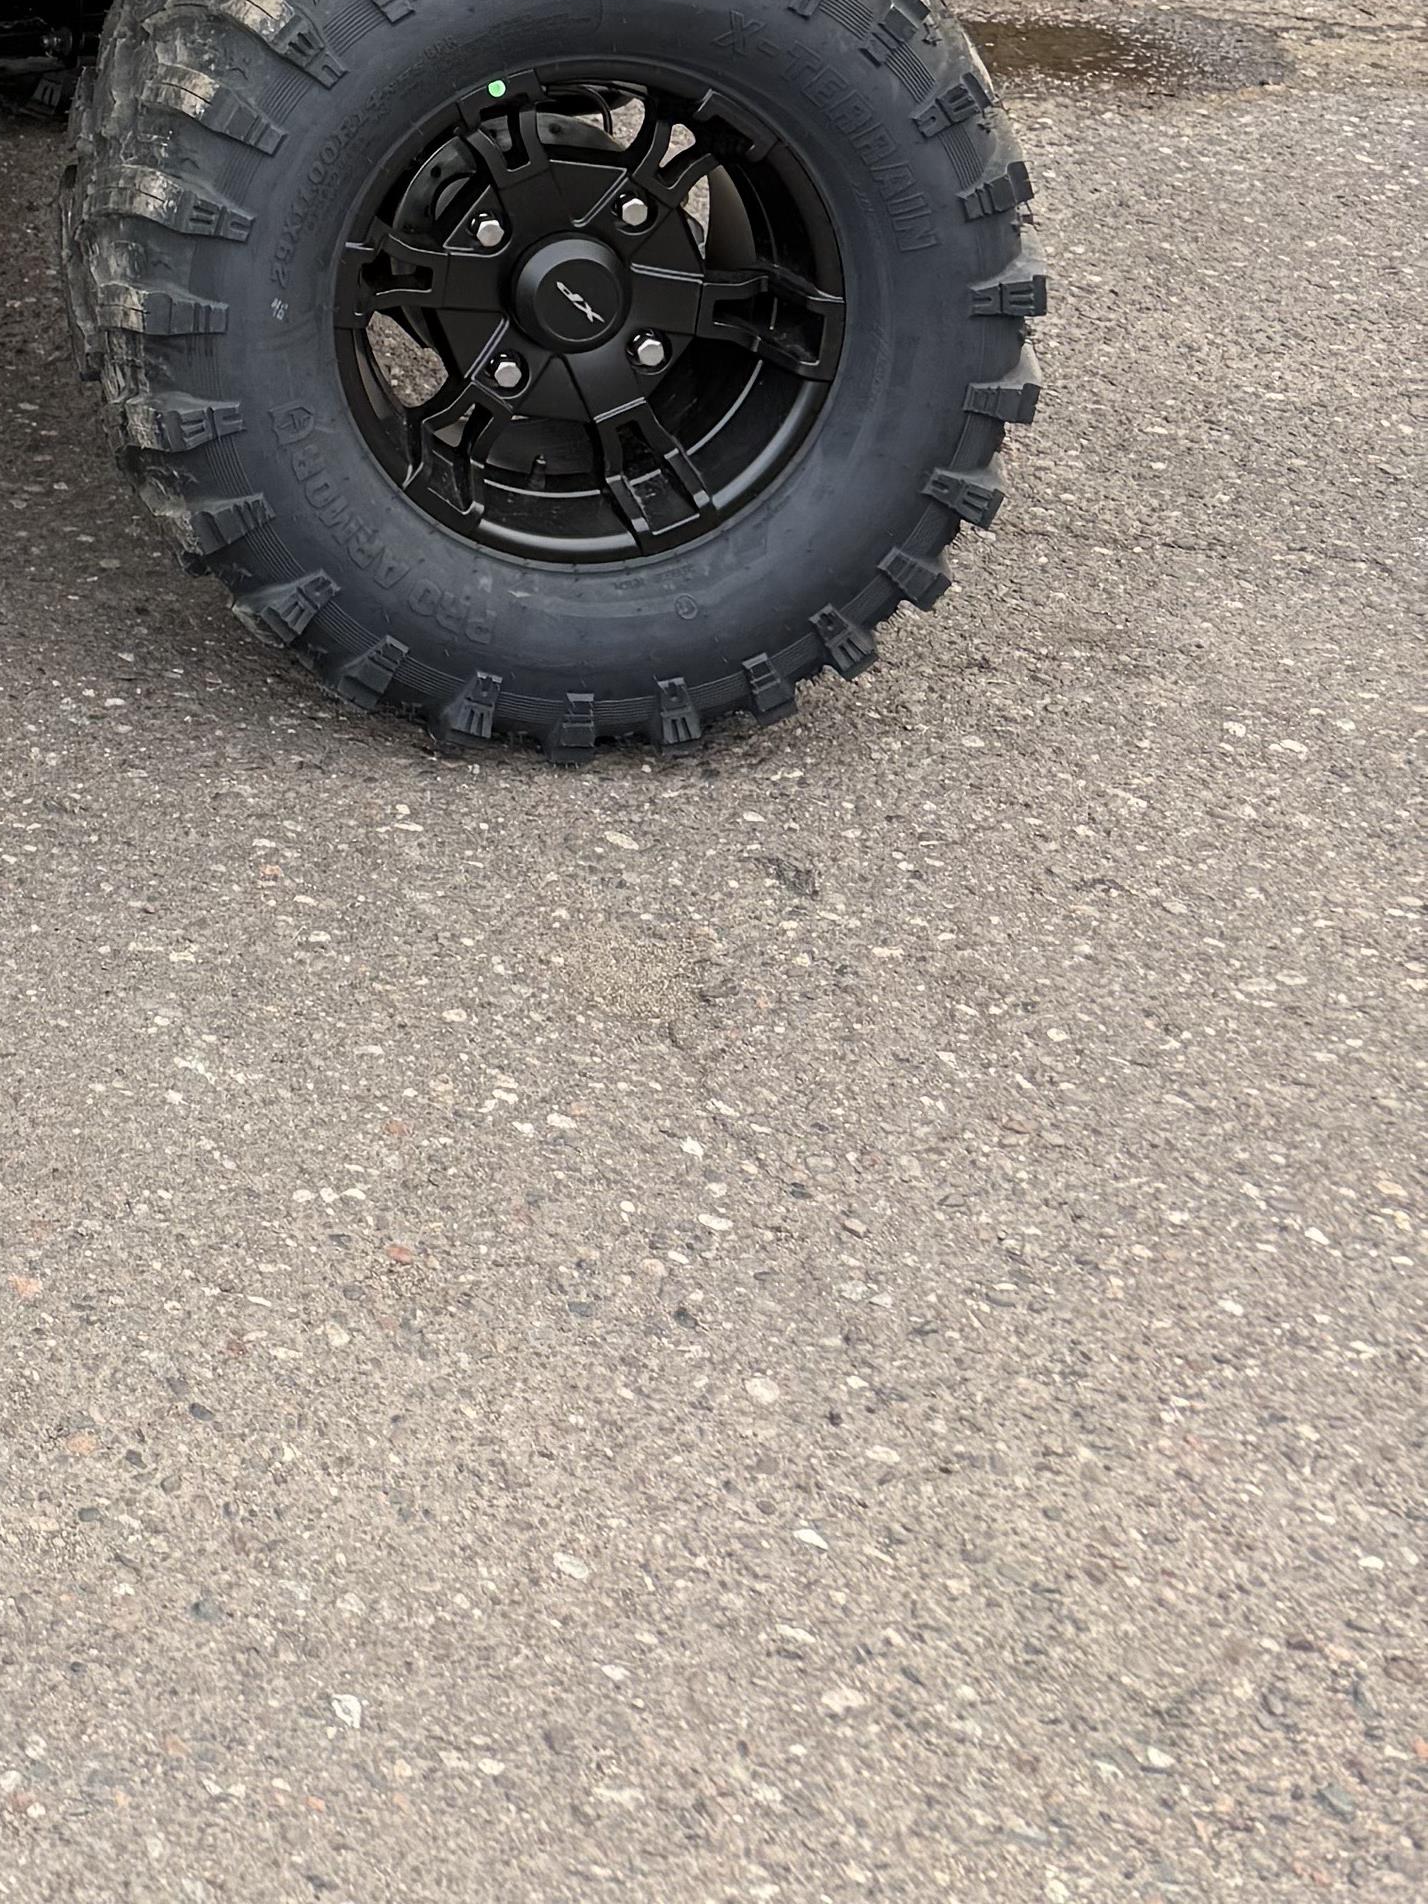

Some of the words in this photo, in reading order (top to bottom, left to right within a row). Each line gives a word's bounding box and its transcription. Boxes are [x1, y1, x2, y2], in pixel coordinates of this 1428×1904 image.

[714, 8, 942, 253] X-TERRAIN
[556, 281, 605, 323] XP
[408, 578, 495, 644] PRO
